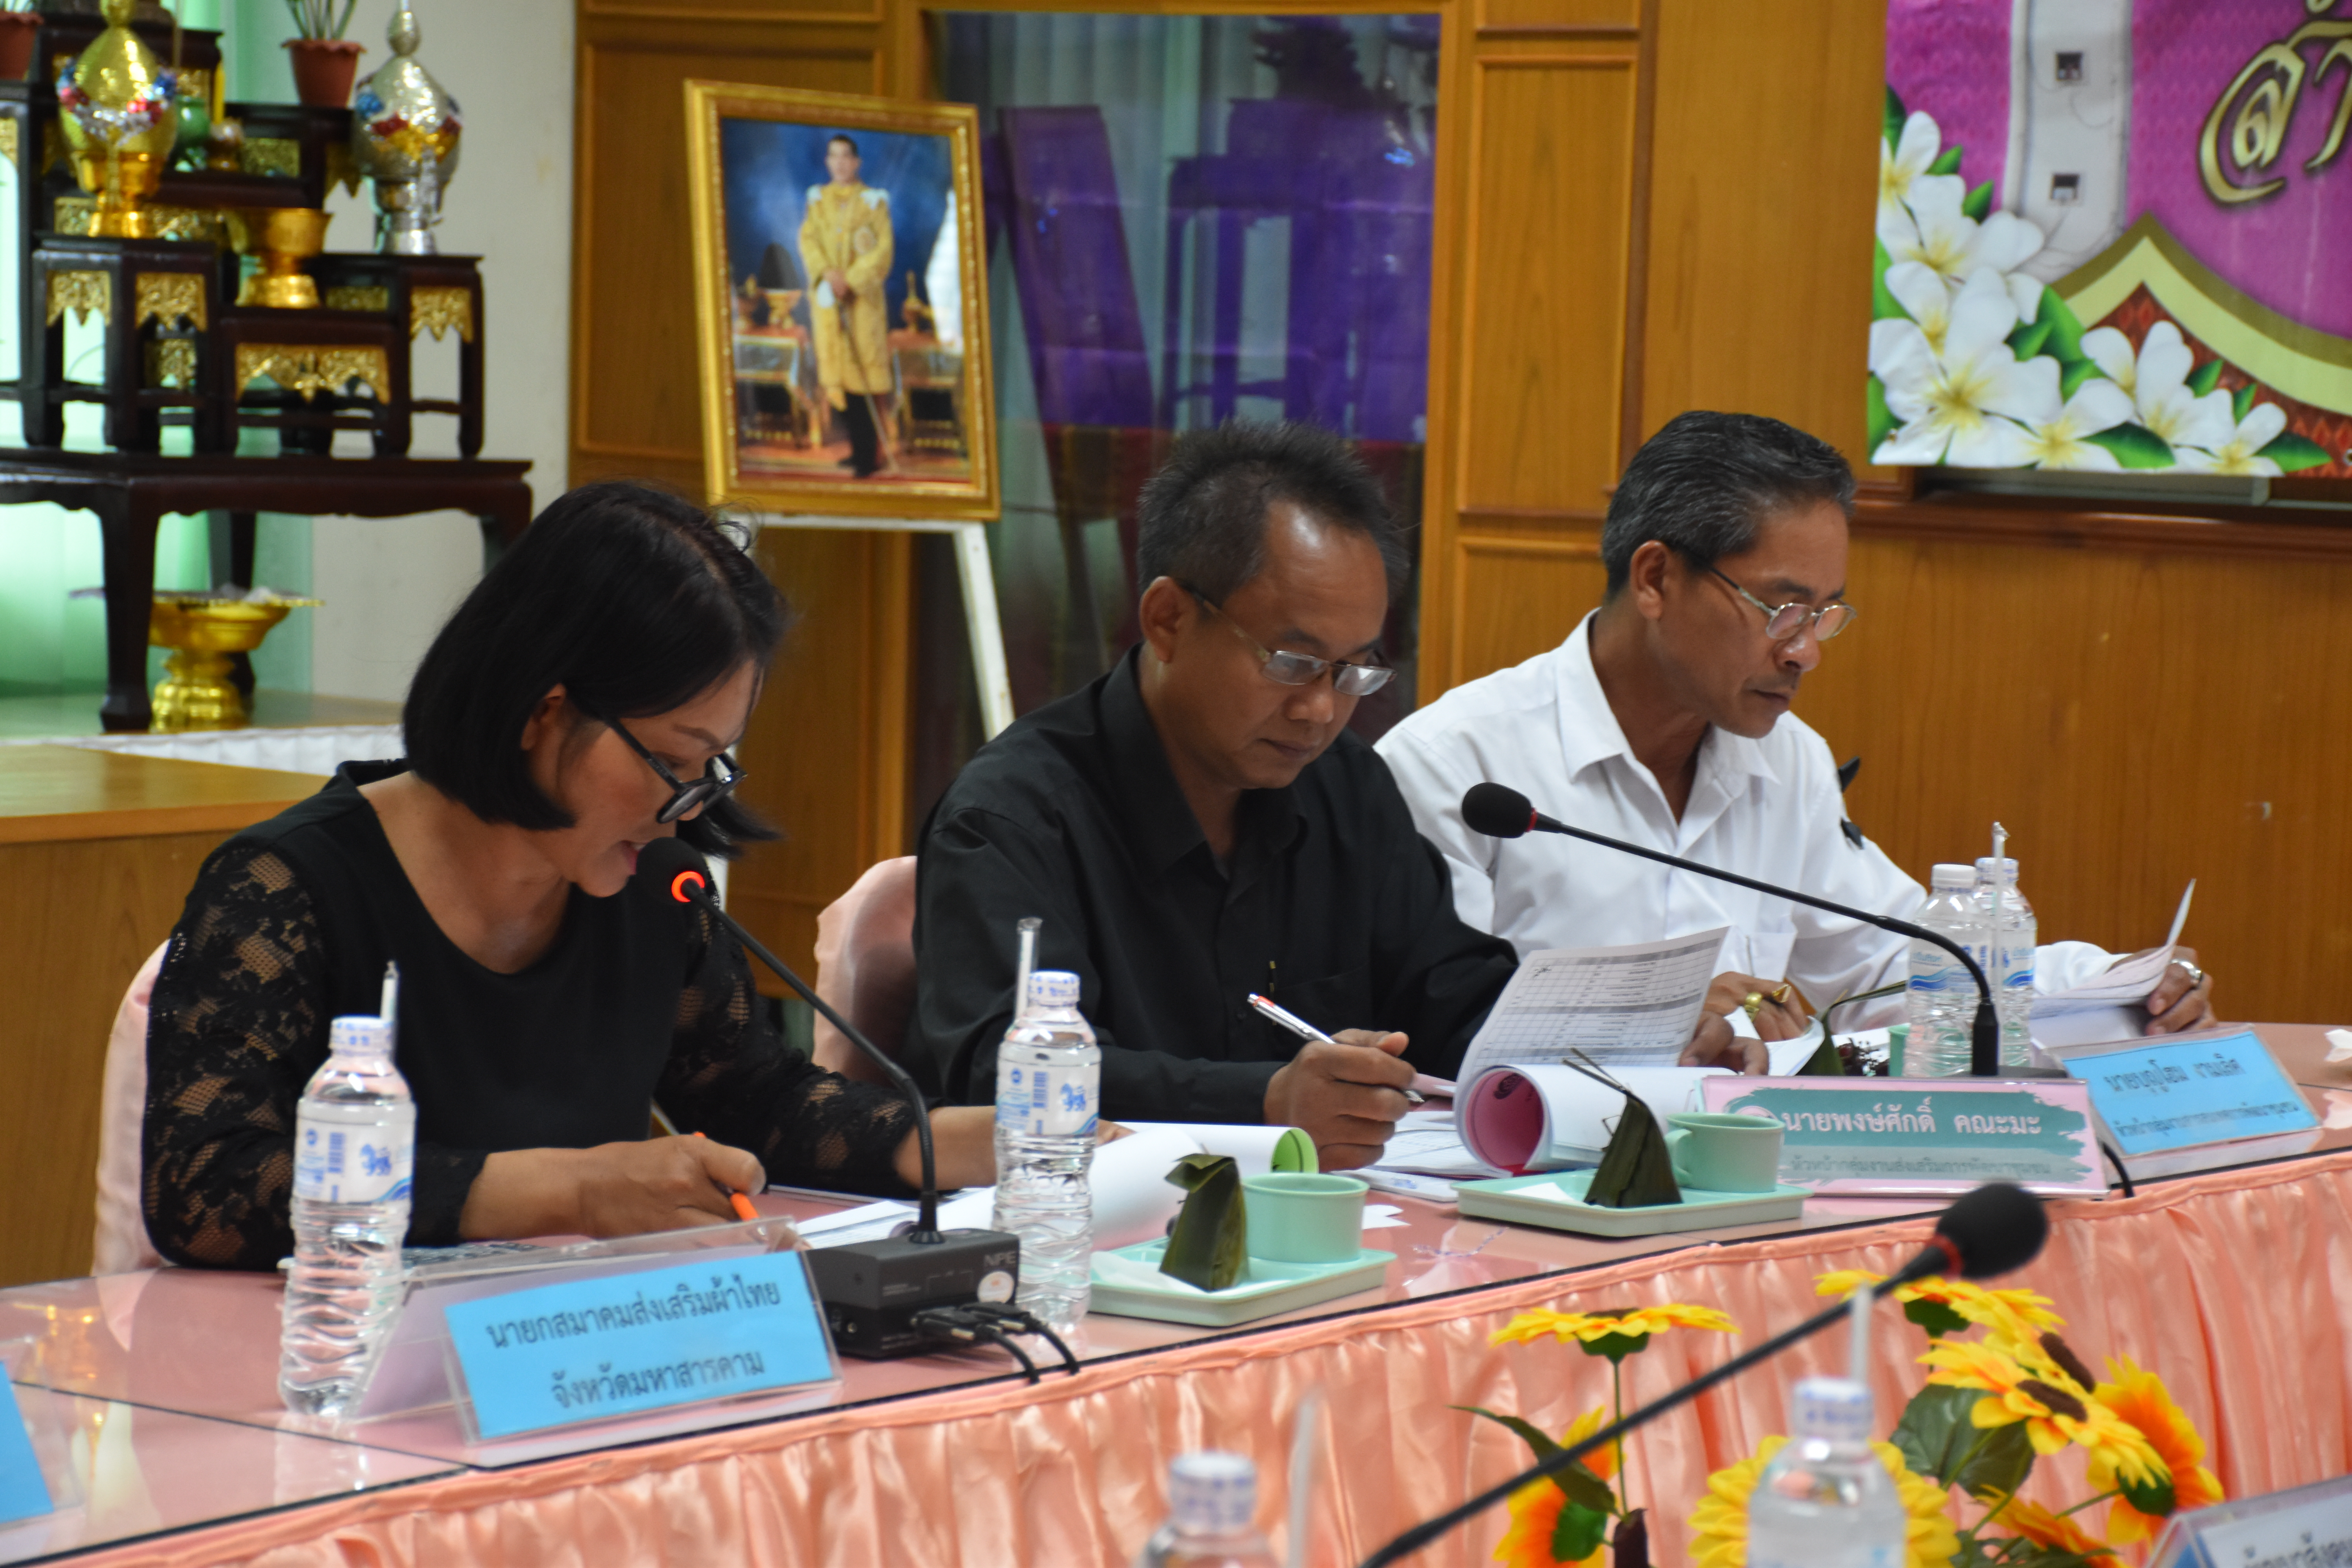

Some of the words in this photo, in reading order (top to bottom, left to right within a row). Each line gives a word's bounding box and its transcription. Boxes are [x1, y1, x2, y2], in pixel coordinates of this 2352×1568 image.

[1782, 1097, 1936, 1133] นายพงษ์ศักดิ์
[486, 1274, 781, 1348] นายกสมาคมส่งเสริมผ้าไทย
[552, 1351, 765, 1408] จังหวัดมหาสารคาม
